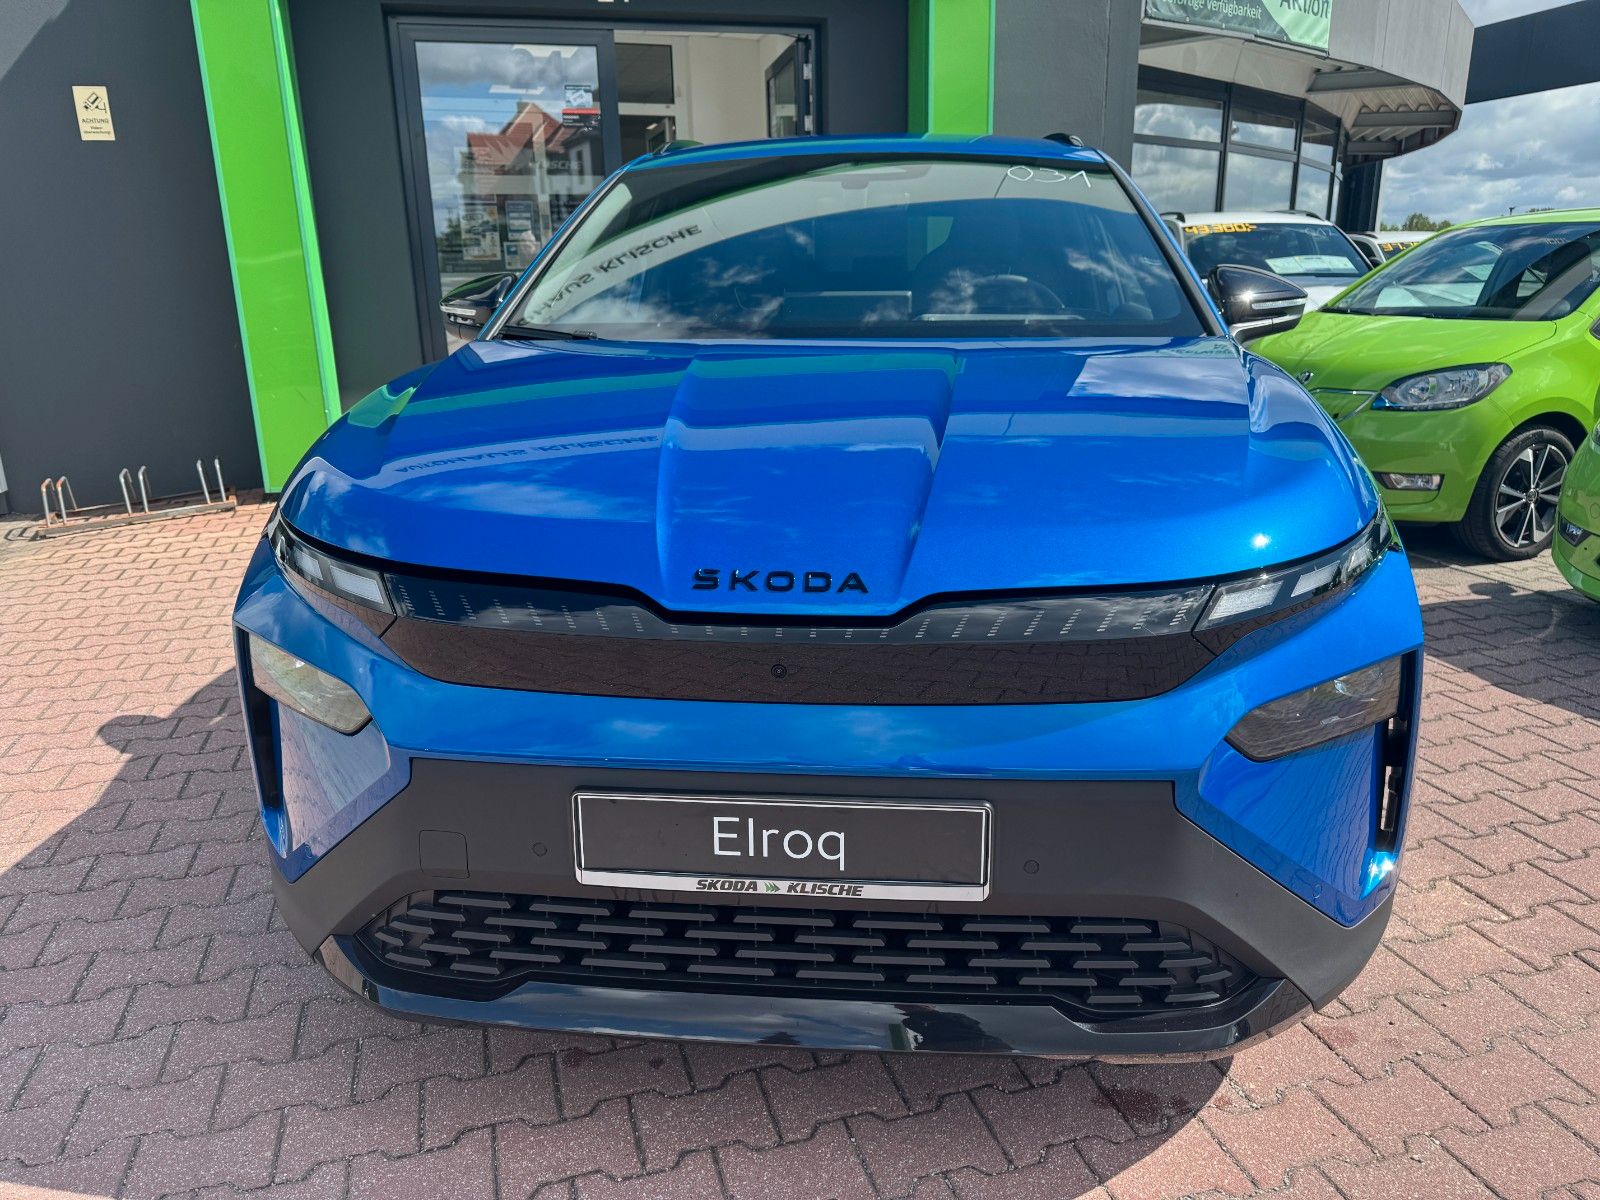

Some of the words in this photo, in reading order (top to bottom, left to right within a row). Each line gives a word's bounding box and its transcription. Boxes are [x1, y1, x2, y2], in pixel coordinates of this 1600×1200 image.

[1007, 165, 1091, 188] 031
[713, 816, 845, 872] Elroq
[786, 882, 864, 897] KLISCHE
